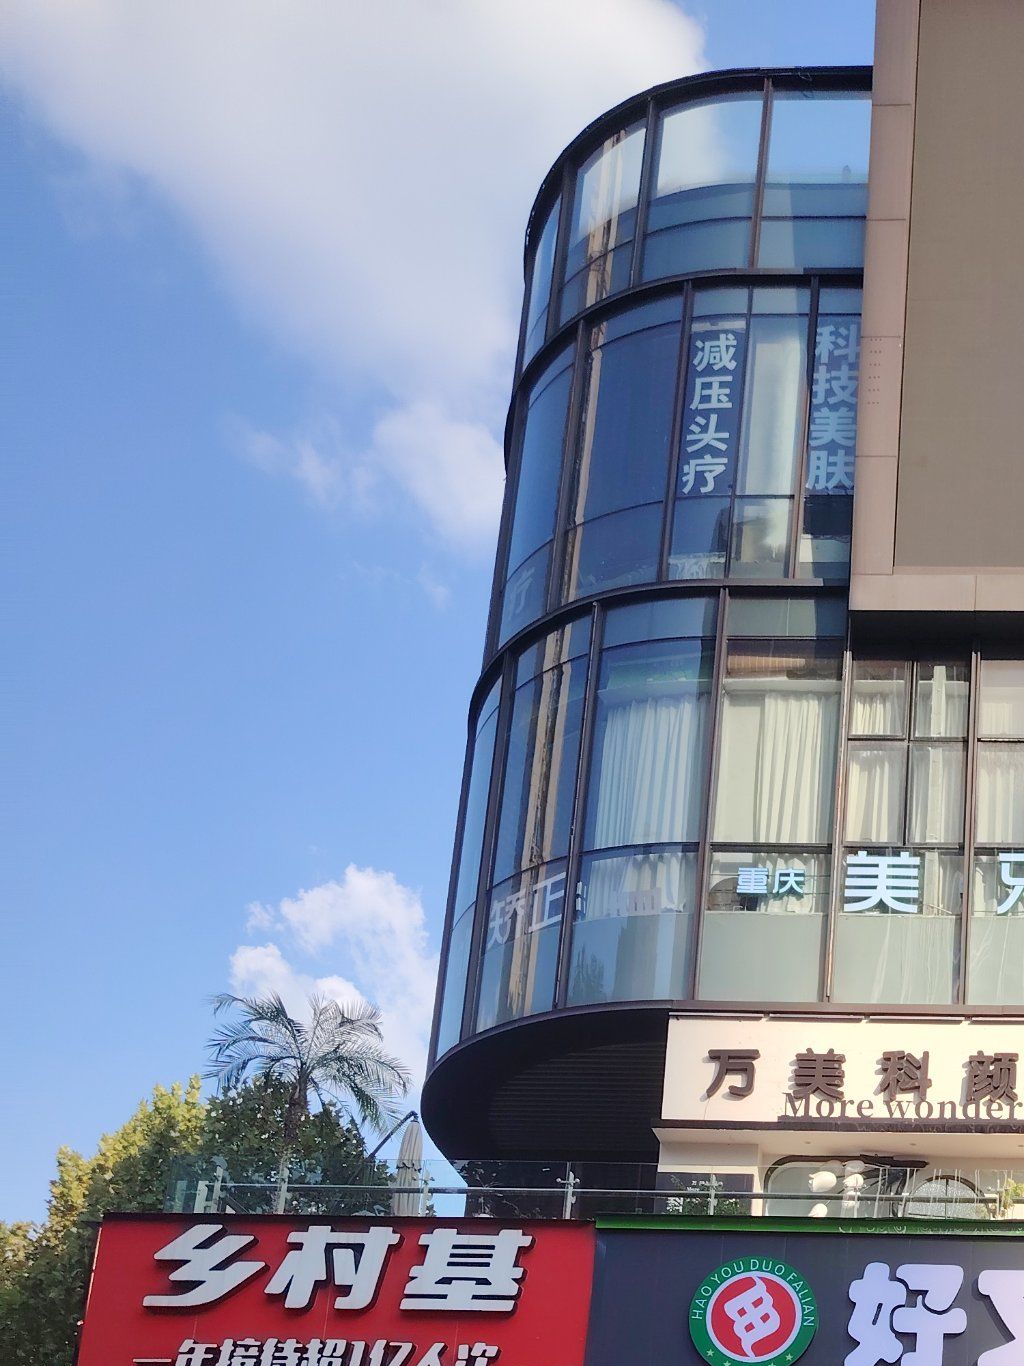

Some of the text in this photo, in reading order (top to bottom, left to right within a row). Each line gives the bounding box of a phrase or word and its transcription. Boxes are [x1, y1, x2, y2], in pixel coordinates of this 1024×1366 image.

[682, 333, 737, 494] 减压头疗
[805, 323, 860, 491] 科技美肤
[737, 867, 805, 895] 重庆
[703, 1048, 1019, 1102] 万美科颜
[782, 1092, 874, 1119] More
[142, 1223, 534, 1313] 乡村基
[691, 1259, 815, 1327] HAO YOU DUO FALIAN
